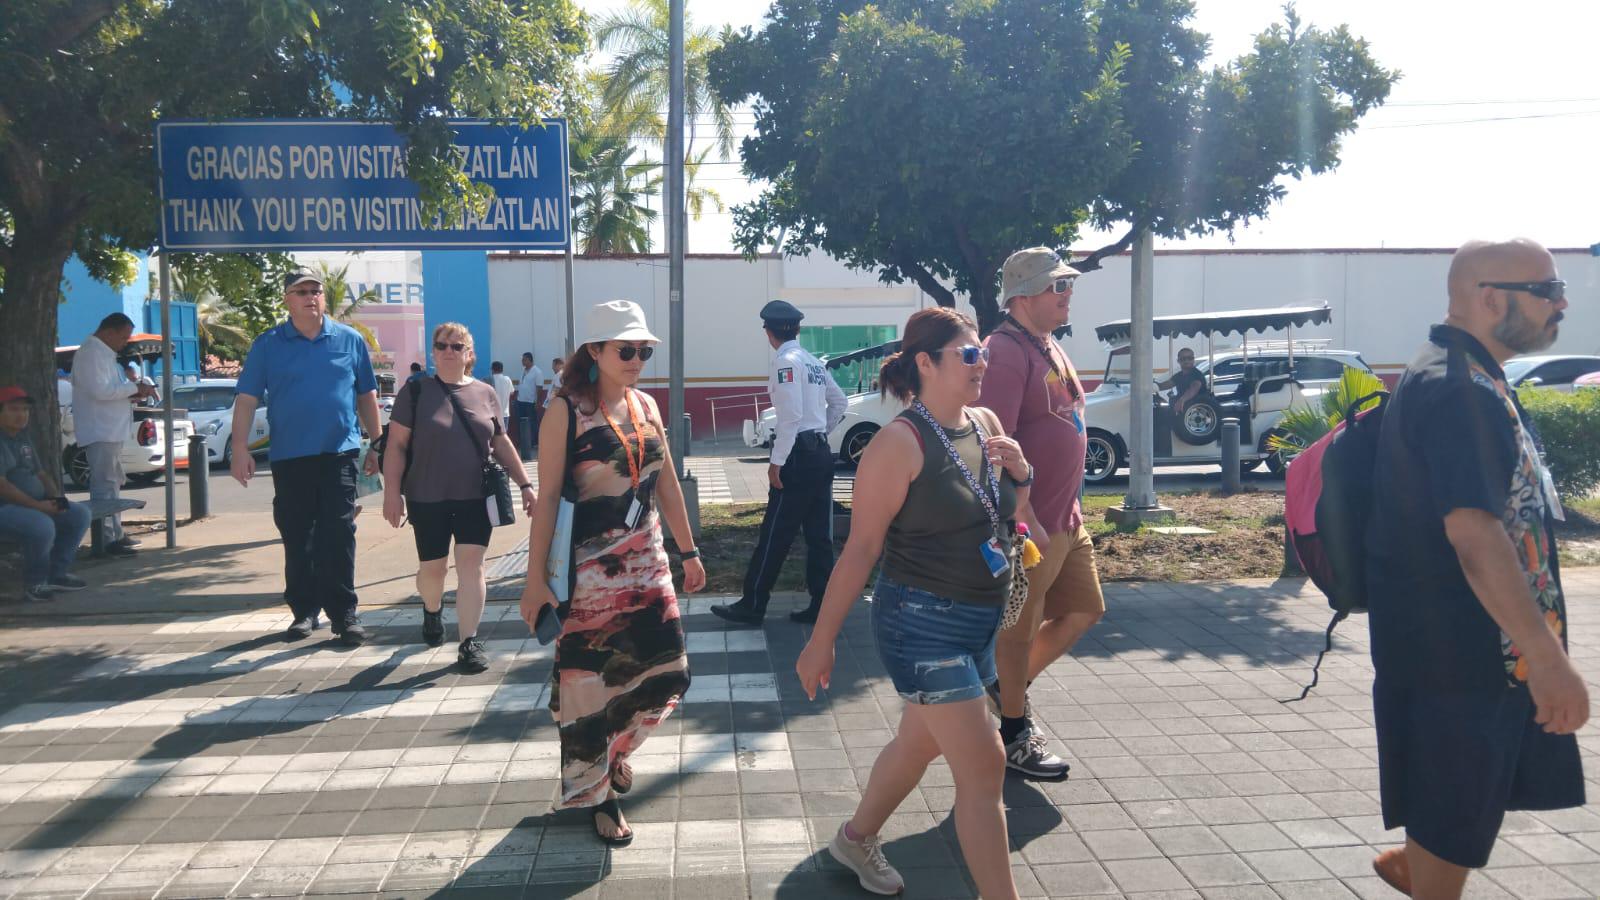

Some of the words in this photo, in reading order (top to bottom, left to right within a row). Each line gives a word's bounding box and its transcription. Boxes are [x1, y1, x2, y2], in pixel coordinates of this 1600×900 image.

[187, 145, 284, 181] GRACIAS
[289, 145, 335, 180] POR
[338, 145, 413, 180] VISITA
[437, 136, 538, 179] ZATLÁN
[169, 198, 245, 232] THANK
[252, 198, 297, 232] YOU
[303, 198, 347, 232] FOR
